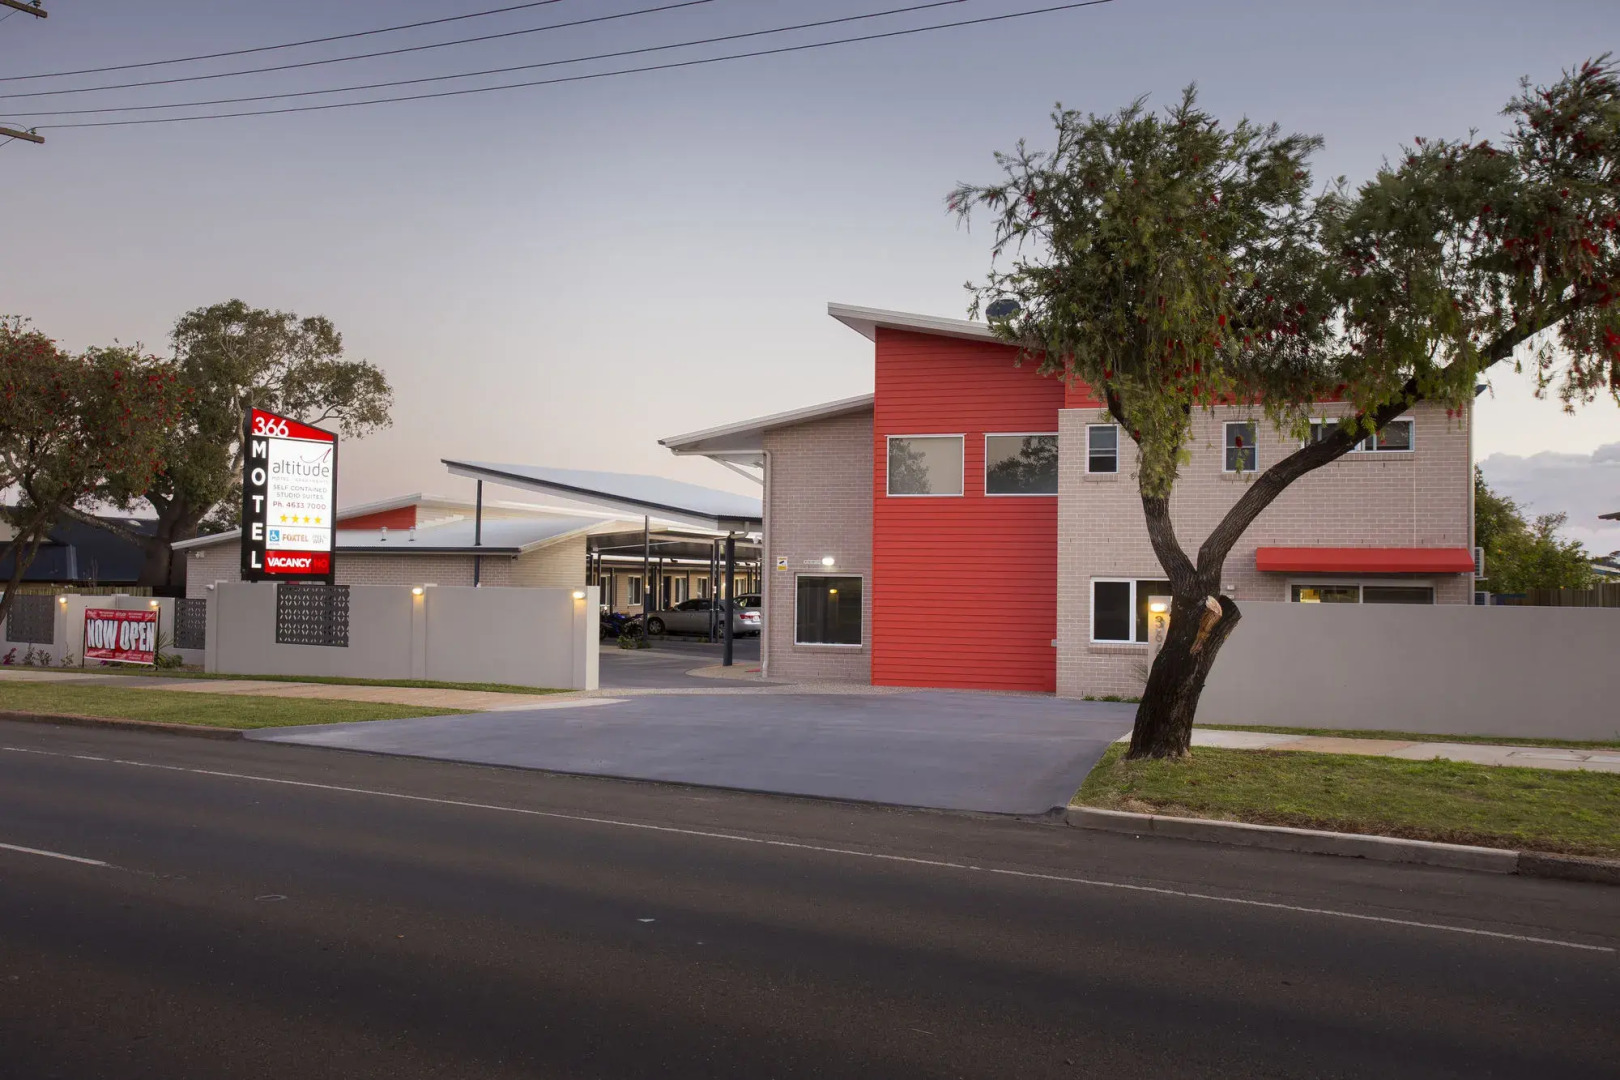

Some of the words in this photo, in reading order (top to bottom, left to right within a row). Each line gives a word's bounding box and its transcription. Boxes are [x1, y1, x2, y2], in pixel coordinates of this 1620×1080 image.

[254, 417, 289, 437] 366
[272, 460, 330, 477] altitude
[290, 485, 328, 493] CONTAINED
[251, 440, 267, 569] MOTEL
[282, 534, 309, 542] FOXTEL
[267, 557, 312, 568] VACANCY
[87, 619, 119, 650] NOW
[120, 620, 155, 652] OPEN
